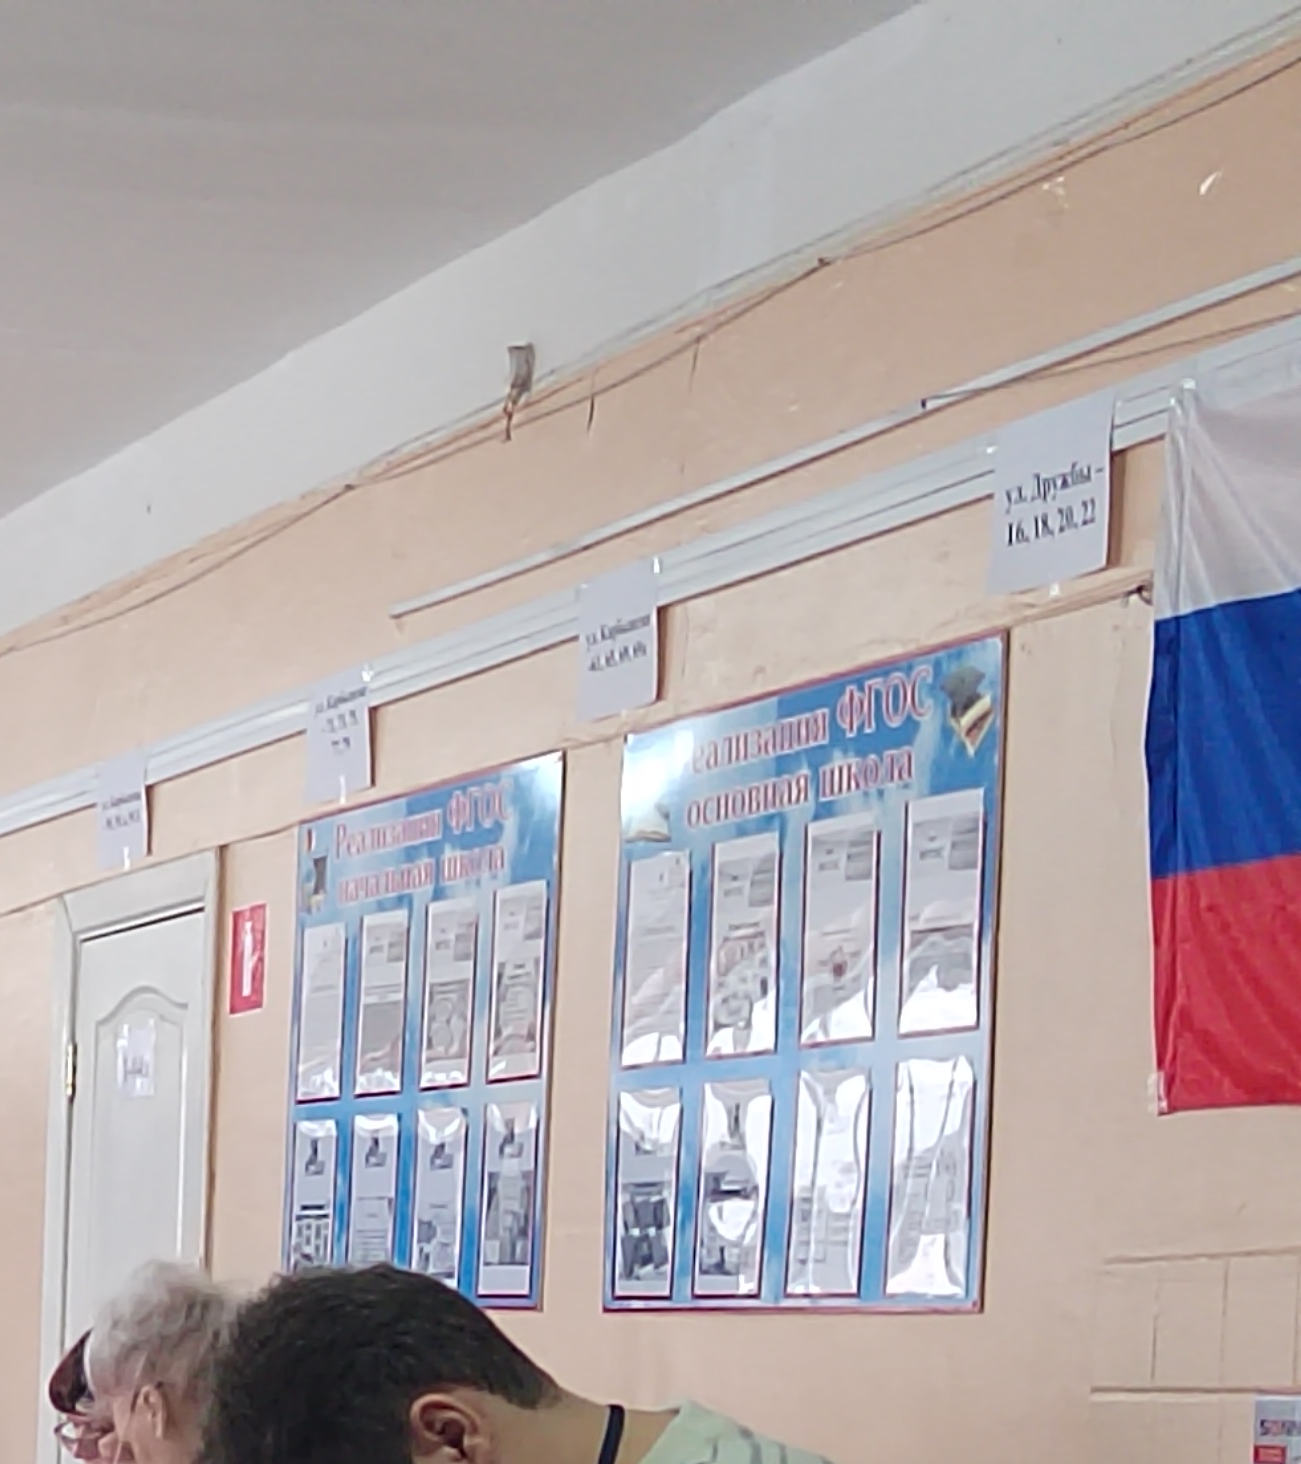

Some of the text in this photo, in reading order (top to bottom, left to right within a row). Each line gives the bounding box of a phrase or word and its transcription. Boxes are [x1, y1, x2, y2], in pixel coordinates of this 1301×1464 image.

[1030, 461, 1092, 503] Дружбы
[1007, 497, 1096, 547] 16, 18, 20, 22
[836, 665, 933, 738] ФГОС
[686, 746, 915, 828] основная школа
[334, 779, 513, 861] Реализация ФГОС
[339, 846, 506, 904] начальная школа
